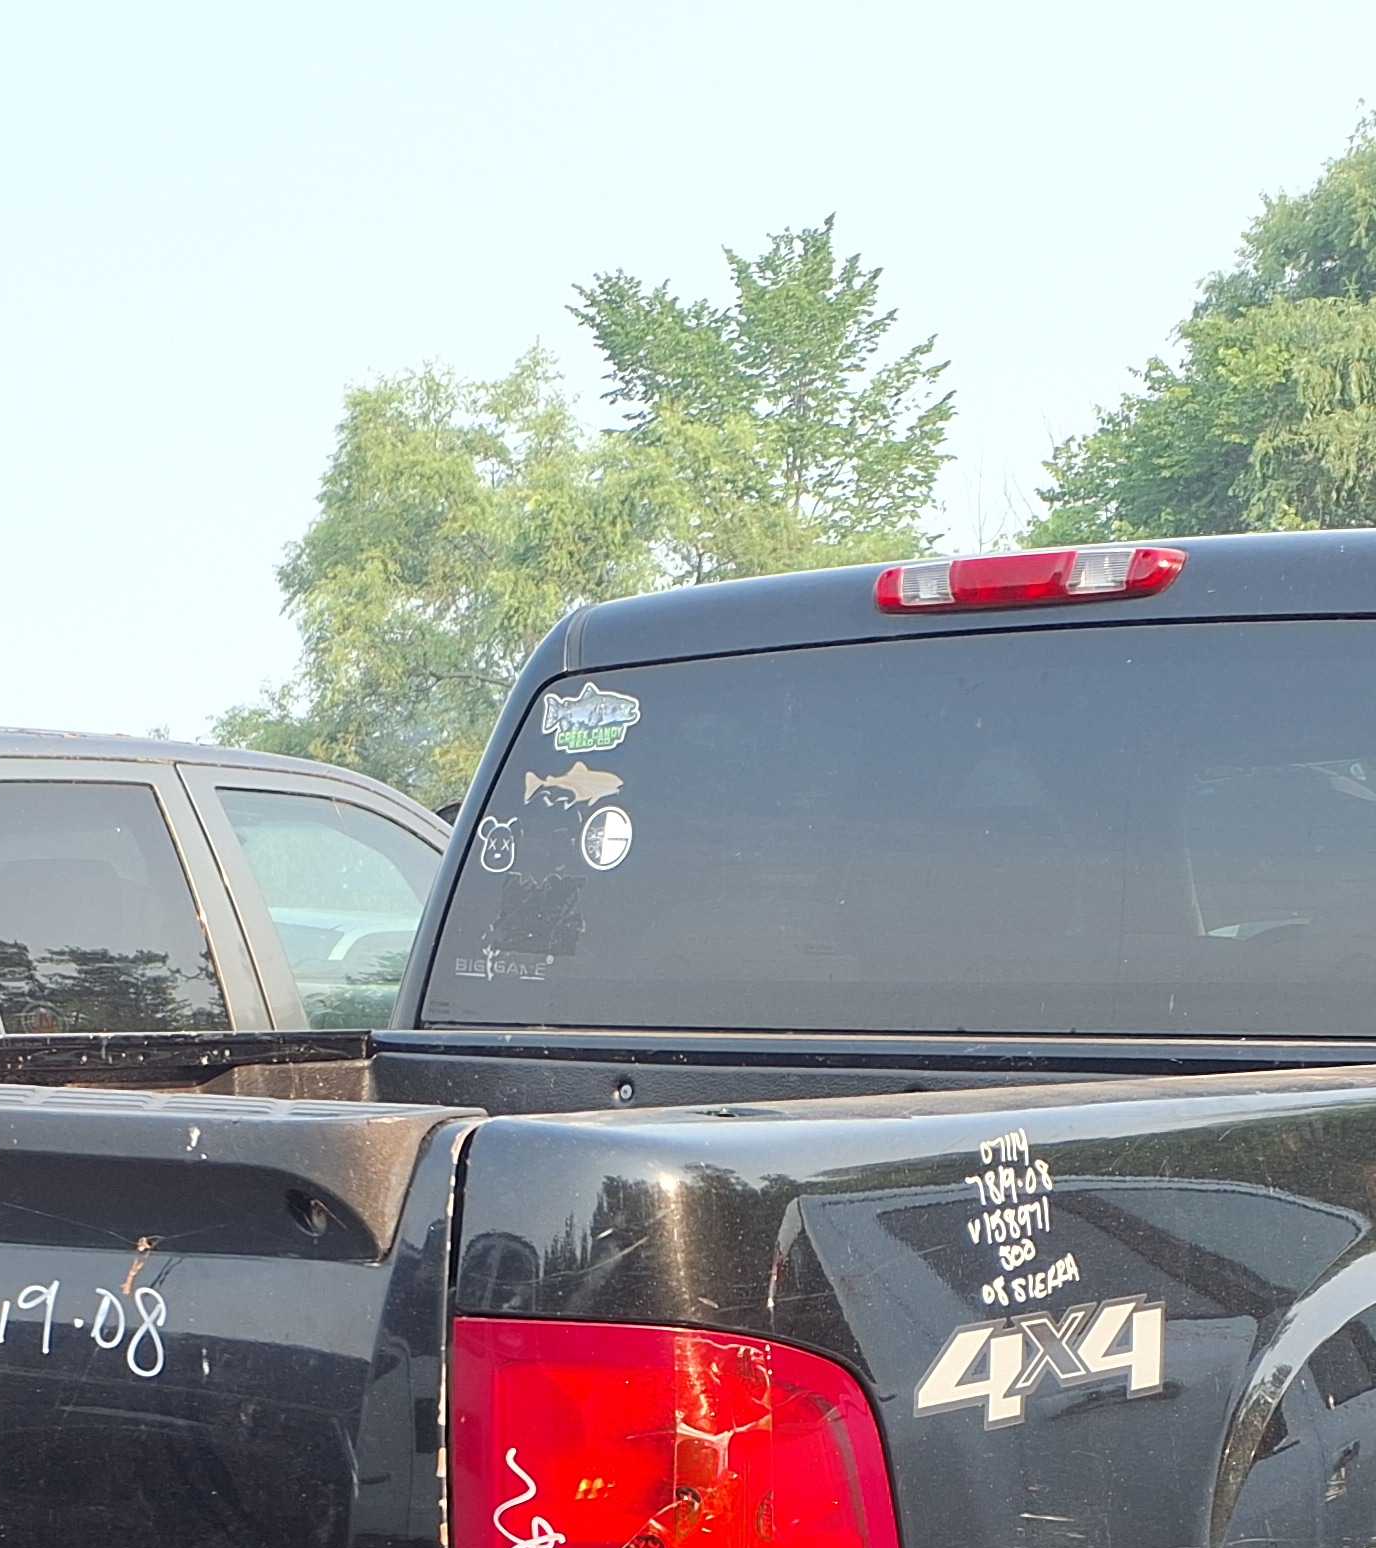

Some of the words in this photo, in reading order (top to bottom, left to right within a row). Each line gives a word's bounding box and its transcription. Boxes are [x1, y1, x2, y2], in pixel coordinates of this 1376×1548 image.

[455, 958, 486, 973] BIG
[982, 1276, 1010, 1306] 08
[1011, 1253, 1080, 1303] SIERRA
